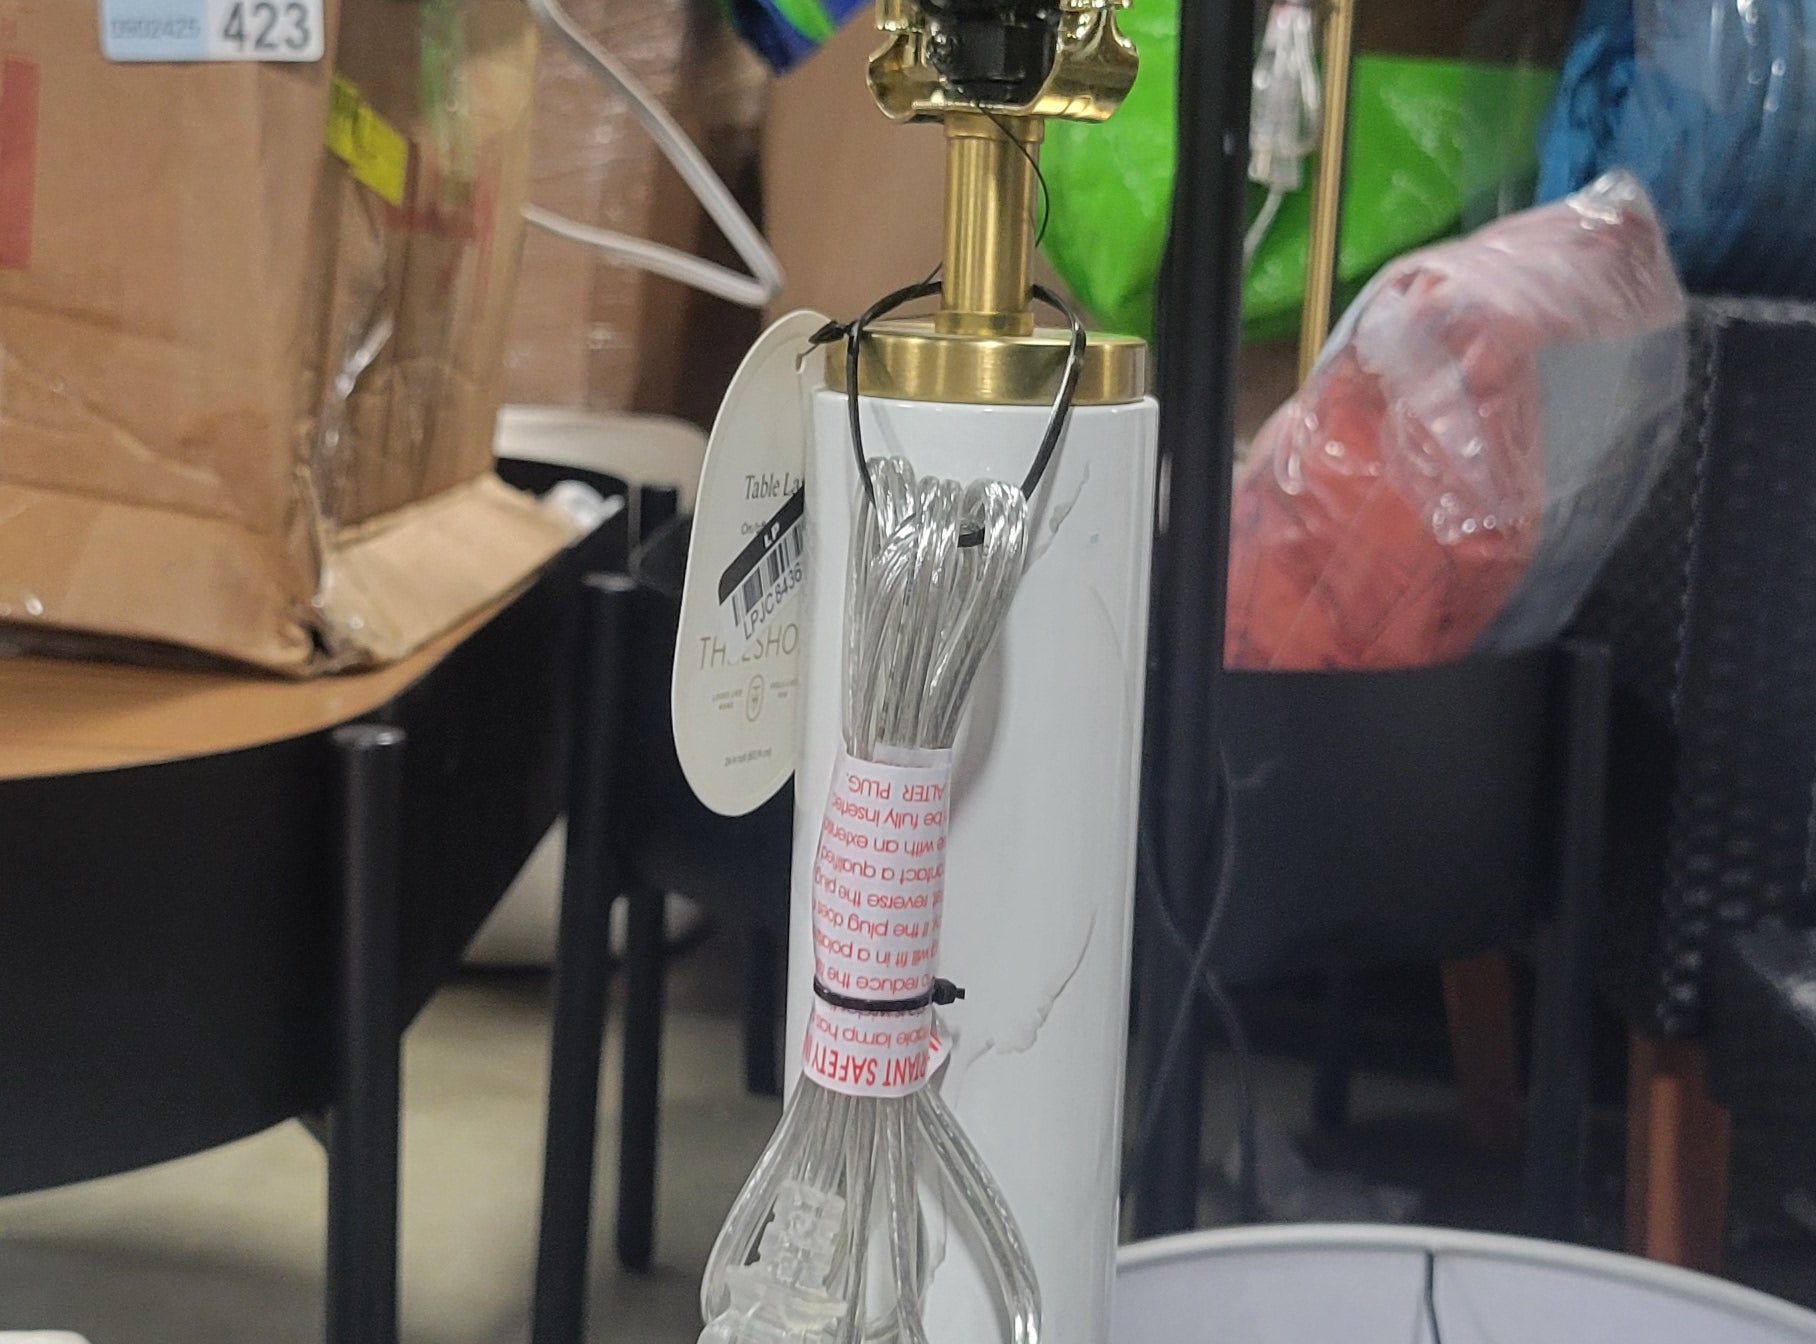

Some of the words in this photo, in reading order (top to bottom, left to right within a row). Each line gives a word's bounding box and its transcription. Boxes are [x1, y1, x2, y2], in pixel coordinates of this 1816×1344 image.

[222, 1, 312, 51] 423
[745, 473, 780, 500] Table
[764, 521, 781, 549] LP
[699, 623, 799, 670] THSHO
[846, 772, 892, 800] PLUG.
[902, 783, 946, 803] ALTER
[884, 807, 919, 830] fully
[874, 837, 899, 854] an
[904, 838, 934, 859] with
[881, 866, 895, 882] a
[838, 885, 861, 907] the
[867, 893, 928, 910] reverse
[847, 913, 889, 940] plug
[893, 923, 919, 939] the
[857, 947, 871, 962] a
[876, 949, 891, 968] in
[826, 966, 850, 990] the
[856, 975, 919, 995] reduce
[842, 1026, 892, 1048] lamp
[811, 1042, 878, 1087] SAFETY
